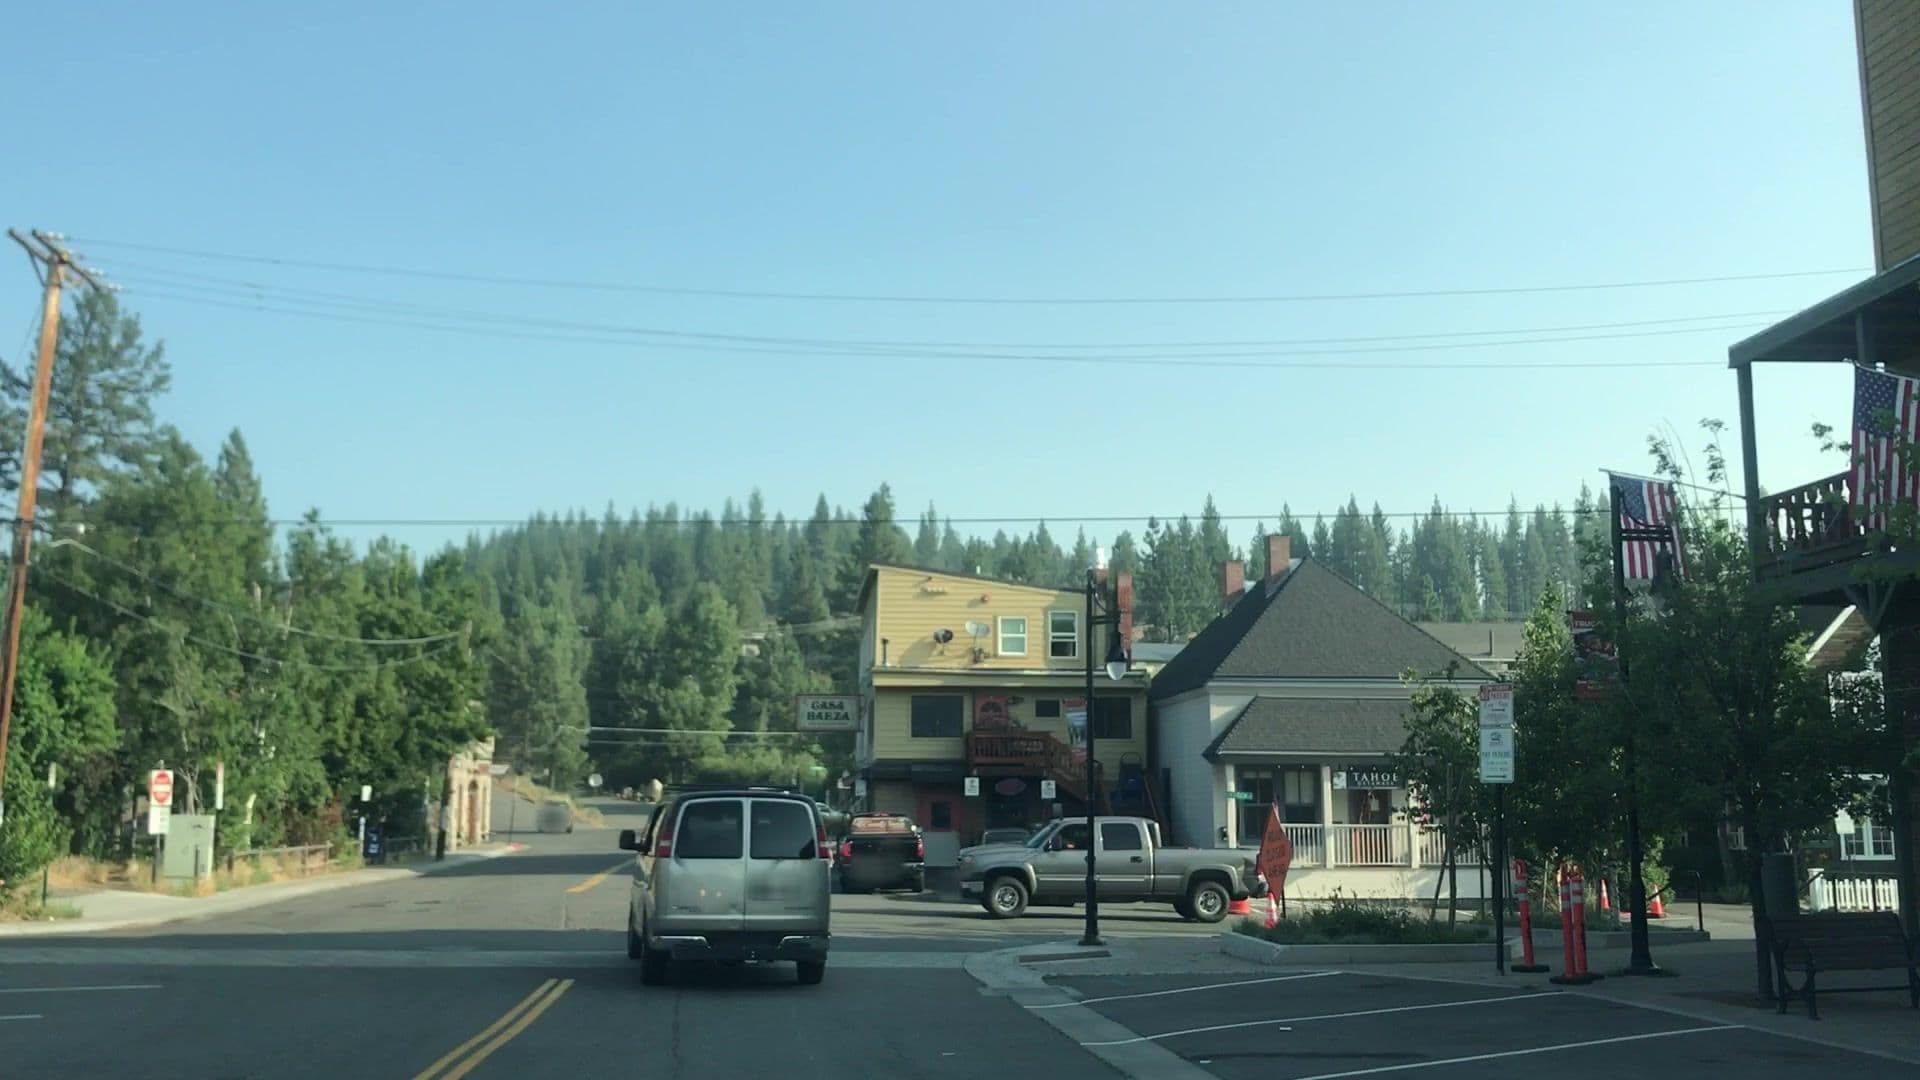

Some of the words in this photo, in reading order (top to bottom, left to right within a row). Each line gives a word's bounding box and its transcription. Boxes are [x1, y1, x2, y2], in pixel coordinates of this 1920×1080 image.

[811, 701, 844, 710] CASA
[807, 711, 850, 721] BAEZA
[1352, 772, 1398, 782] TAHOE
